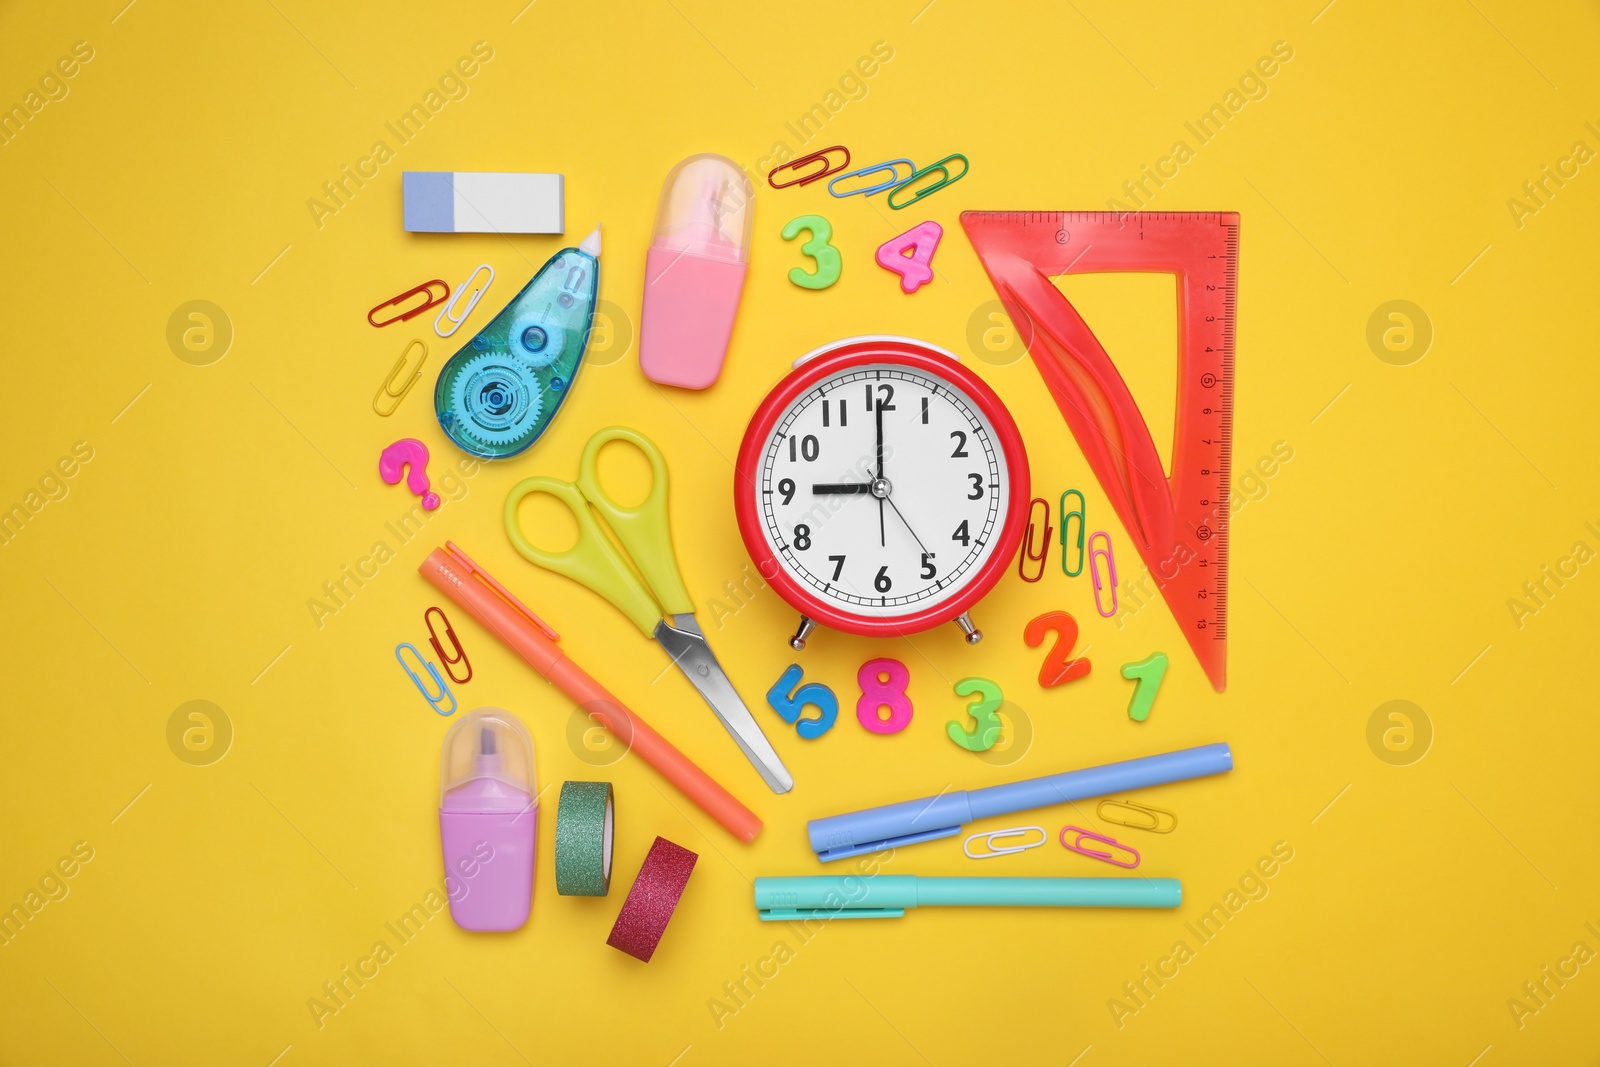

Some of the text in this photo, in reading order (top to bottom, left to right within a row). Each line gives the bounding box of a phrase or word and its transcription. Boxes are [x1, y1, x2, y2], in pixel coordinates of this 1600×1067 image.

[782, 214, 841, 288] 3
[875, 220, 943, 294] 4
[865, 384, 896, 411] 12
[921, 397, 929, 424] 1
[822, 399, 847, 427] 11
[789, 434, 819, 462] 10
[950, 431, 969, 458] 2
[778, 478, 796, 505] 9
[967, 473, 984, 500] 3
[793, 524, 812, 551] 8
[951, 519, 970, 547] 4
[829, 555, 846, 581] 7
[874, 565, 892, 593] 6
[920, 552, 937, 580] 5
[1024, 610, 1091, 688] 2
[856, 656, 912, 735] 8
[1122, 652, 1168, 721] 1
[766, 663, 839, 740] 5
[946, 677, 1003, 752] 3
